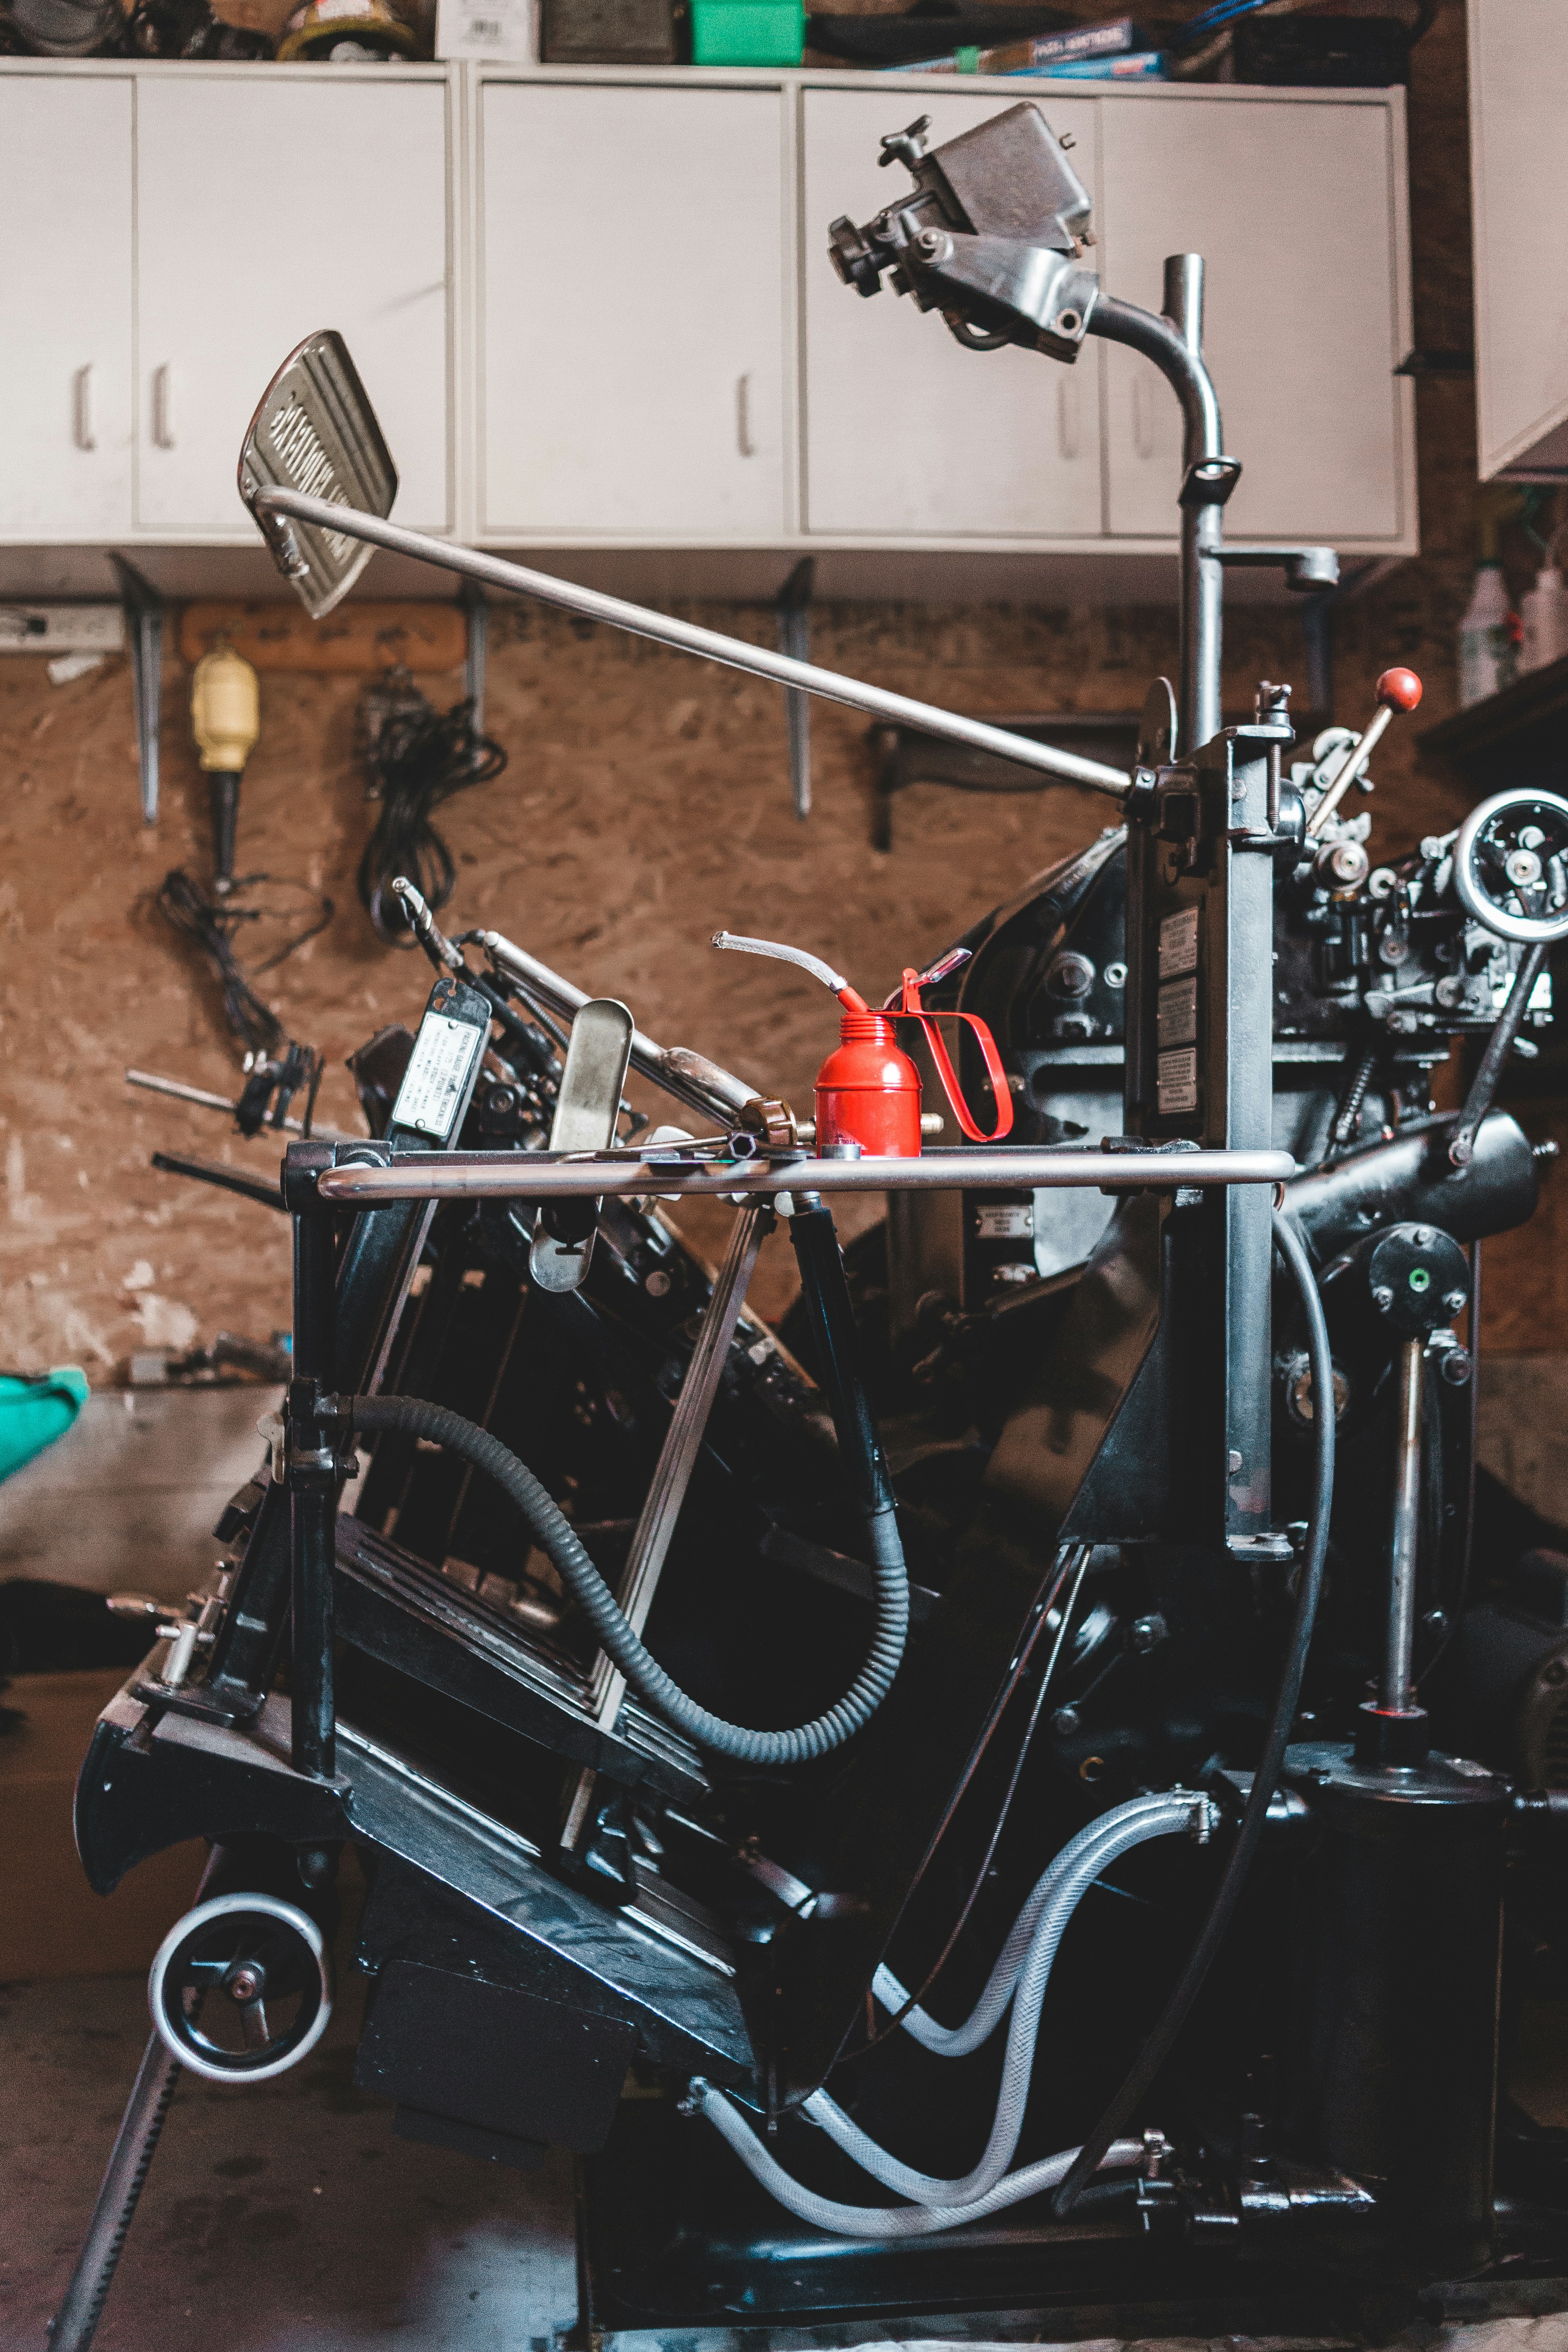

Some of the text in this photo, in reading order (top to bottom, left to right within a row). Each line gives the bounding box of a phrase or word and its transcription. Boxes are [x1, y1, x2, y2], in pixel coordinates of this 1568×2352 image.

[458, 1031, 472, 1054] PACKING
[434, 1048, 445, 1065] HEAVY
[428, 1067, 438, 1084] STOCK
[410, 1097, 419, 1113] SHEET
[434, 1097, 450, 1127] THICKNESS
